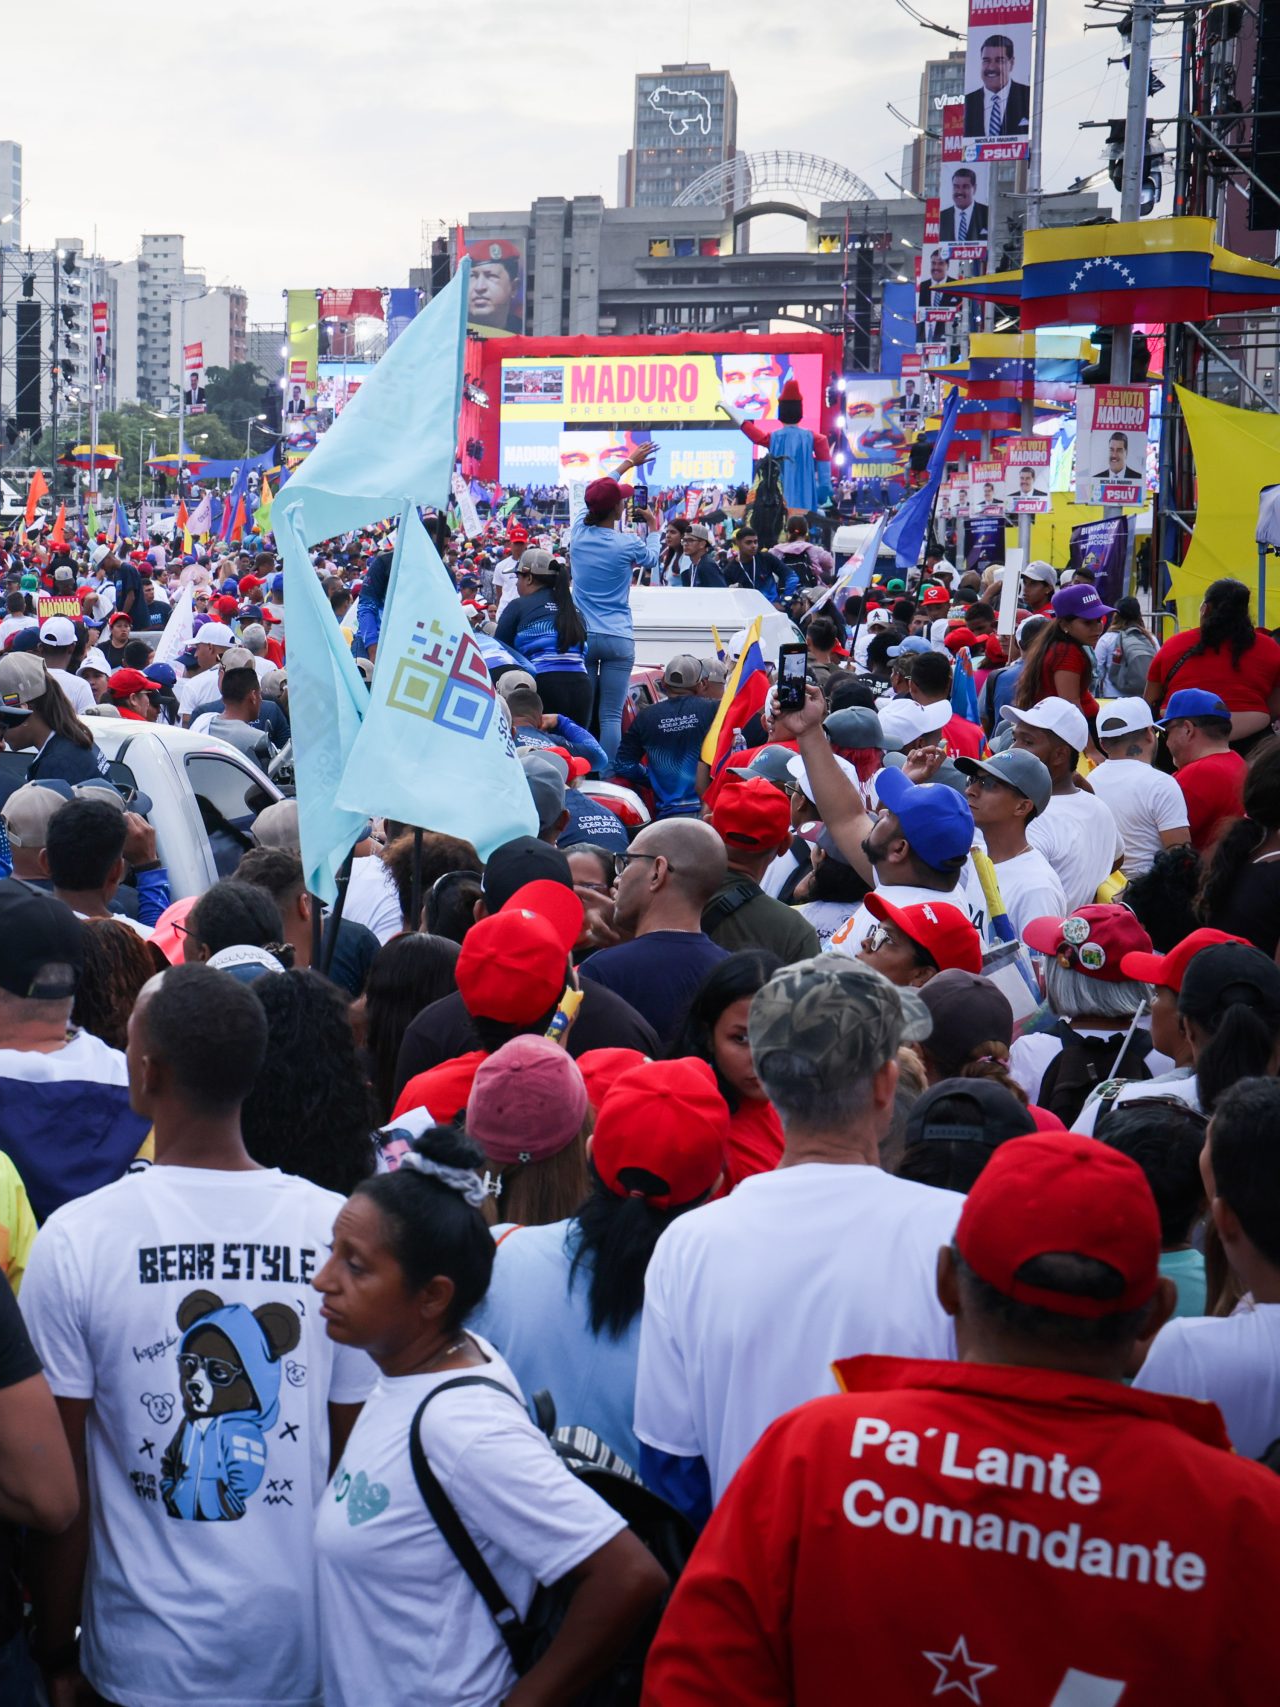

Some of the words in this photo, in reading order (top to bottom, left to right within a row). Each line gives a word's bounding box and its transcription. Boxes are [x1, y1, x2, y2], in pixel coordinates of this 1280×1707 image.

[570, 362, 699, 404] MADURO
[1120, 391, 1144, 407] VOTA
[570, 405, 696, 415] PRESIDENTE
[1097, 406, 1145, 425] MADURO
[1010, 450, 1047, 462] MADURO
[40, 601, 80, 617] MADURO
[139, 1243, 216, 1284] BEAR
[221, 1243, 316, 1285] STYLE
[842, 1478, 1207, 1591] Comandante
